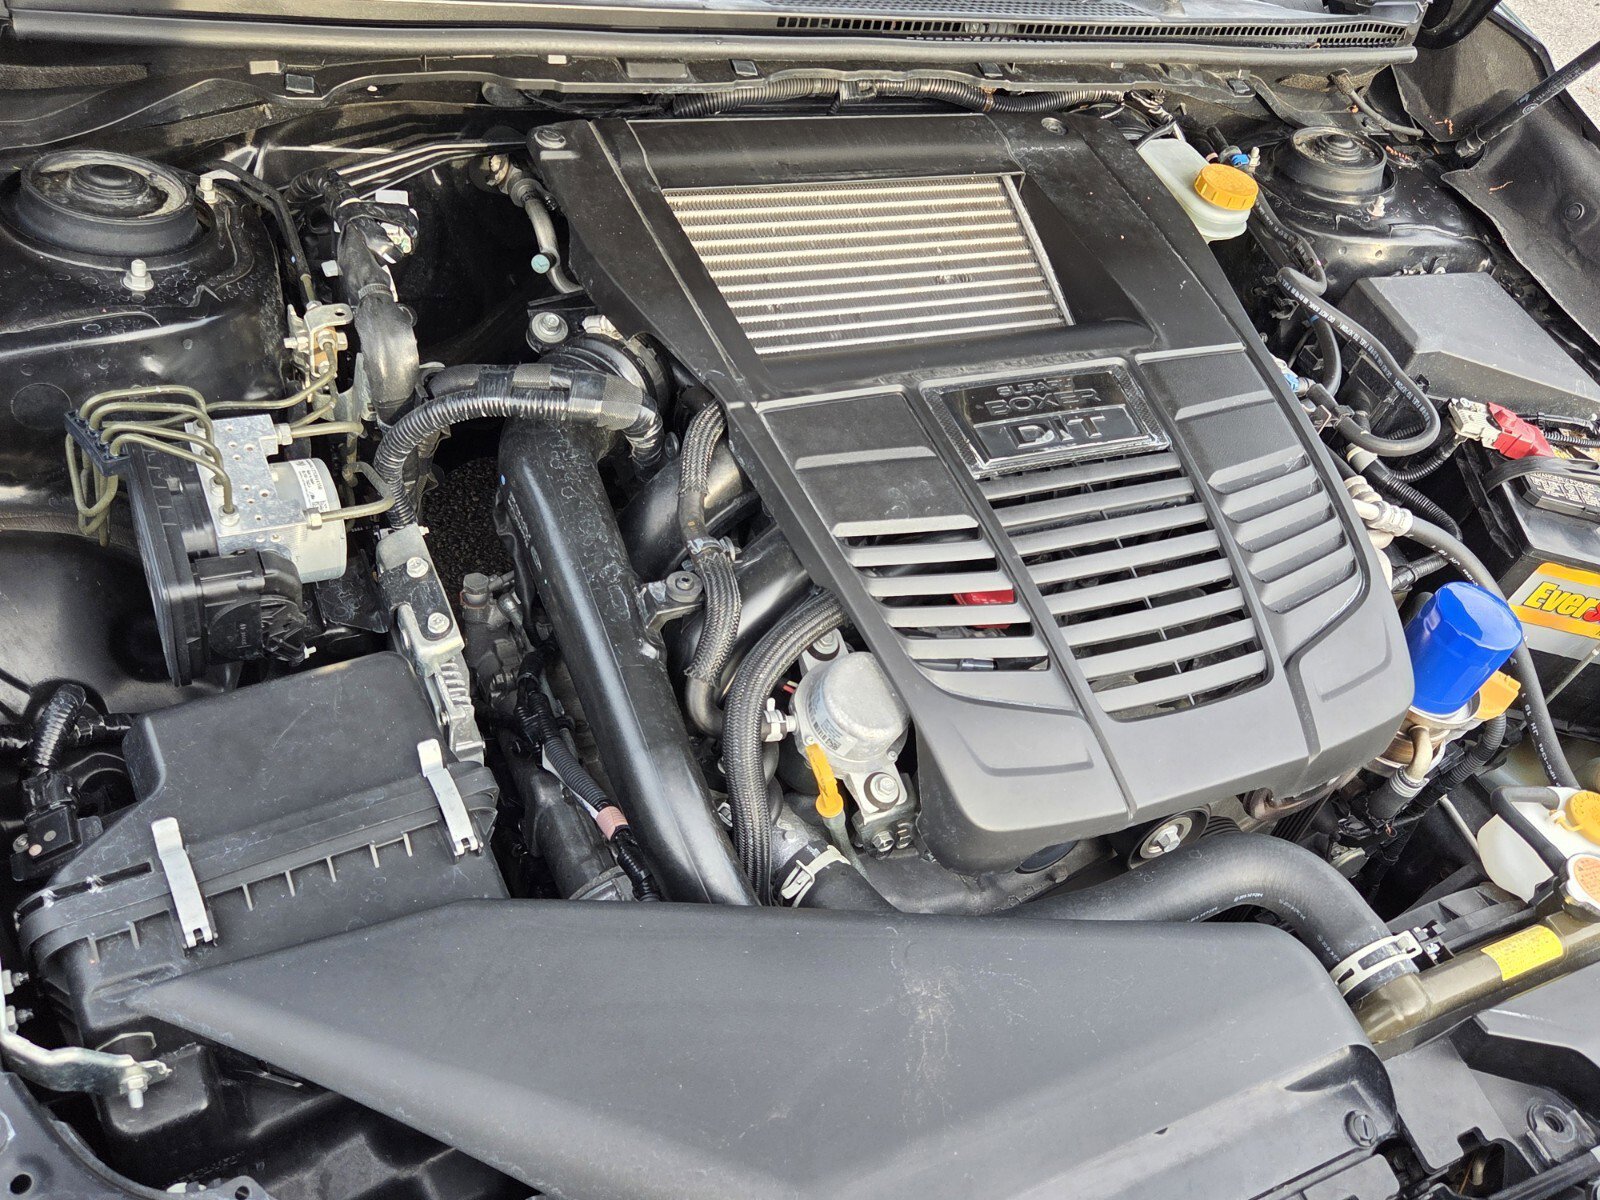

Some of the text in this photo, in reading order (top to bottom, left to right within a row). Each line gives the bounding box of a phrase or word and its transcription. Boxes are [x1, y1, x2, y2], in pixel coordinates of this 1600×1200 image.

[985, 388, 1102, 416] BOXER
[1003, 414, 1106, 449] DIT
[1530, 722, 1539, 737] JH
